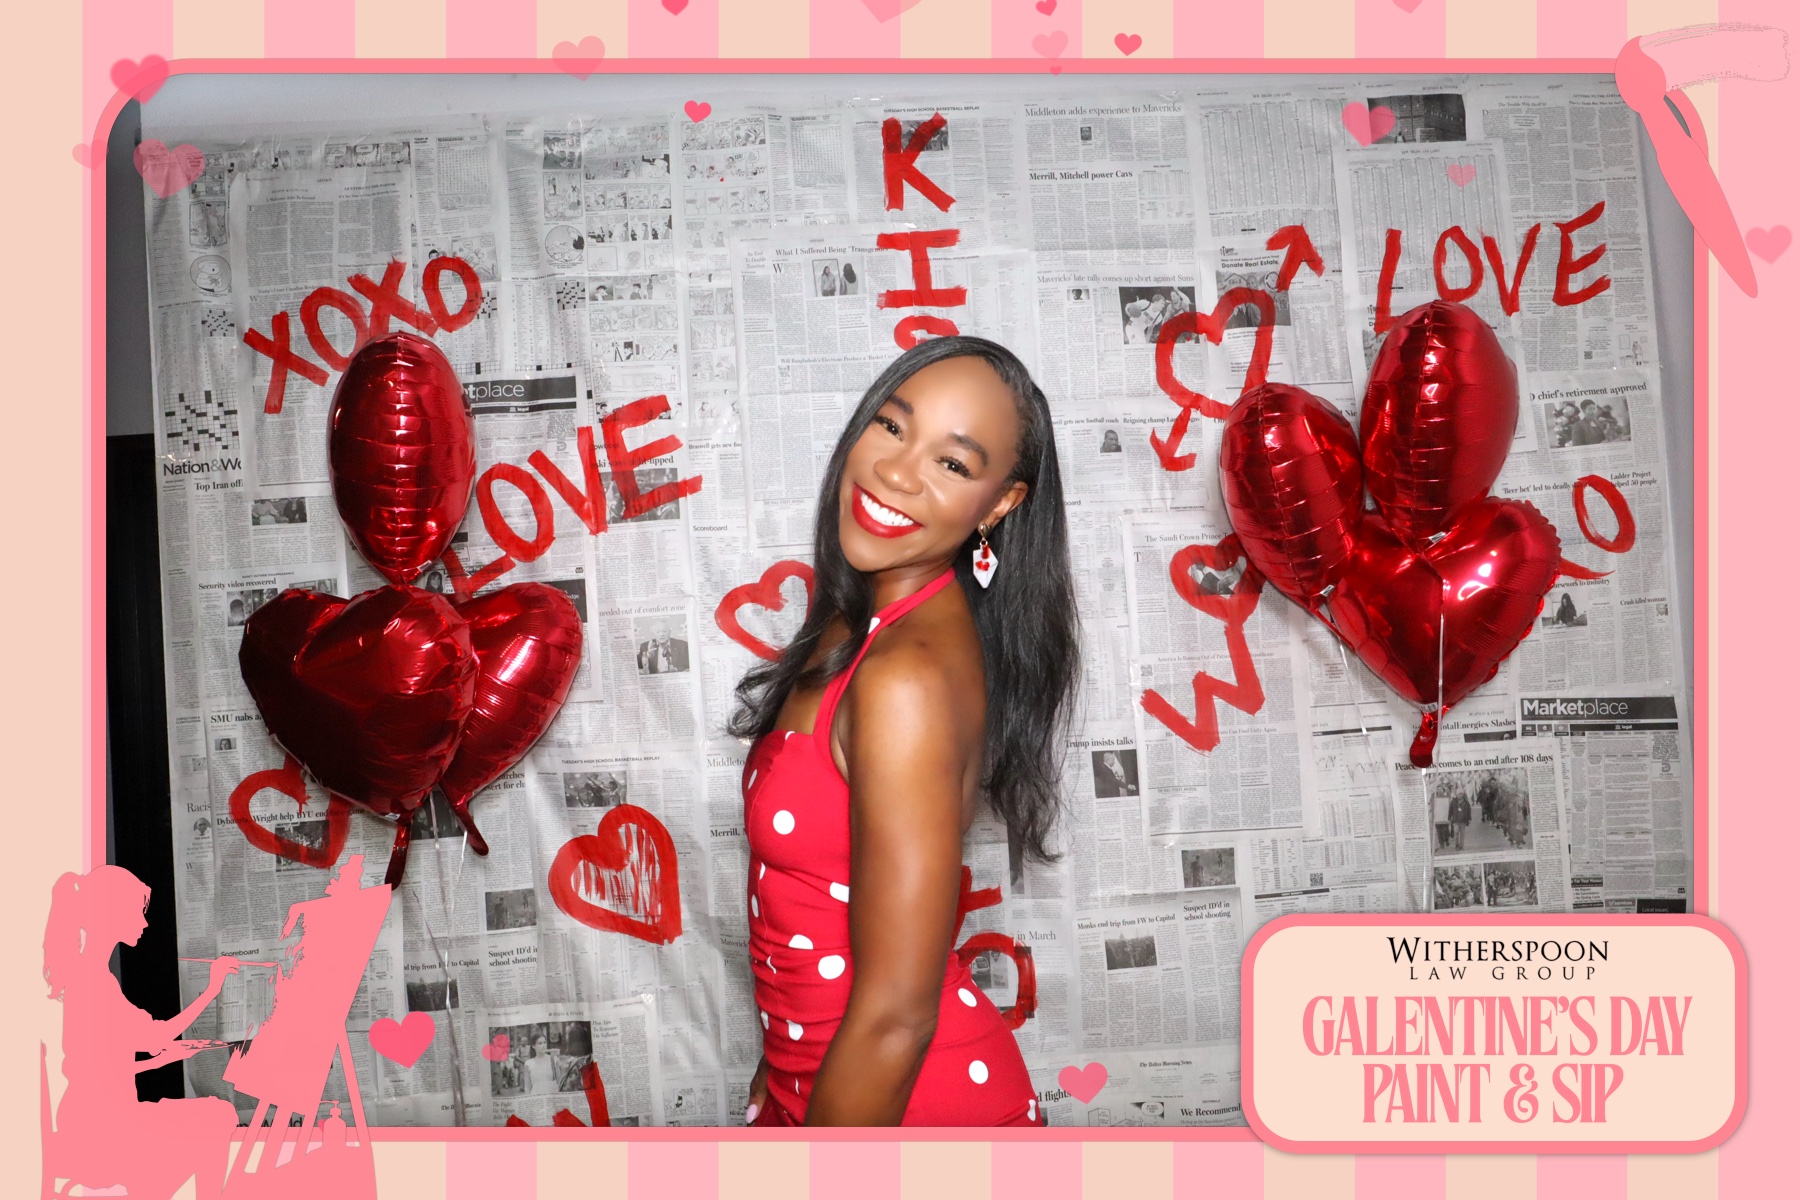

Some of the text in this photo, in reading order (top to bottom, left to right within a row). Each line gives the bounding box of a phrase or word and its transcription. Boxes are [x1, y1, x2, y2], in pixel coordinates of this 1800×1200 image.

[1025, 102, 1182, 117] Middleton adds experience to Mavericks
[1029, 169, 1133, 182] Merrill, Mitchell power Cavs
[775, 248, 793, 256] What
[800, 246, 827, 255] Suffered
[828, 246, 847, 256] Being
[1221, 261, 1243, 269] Donate
[1373, 200, 1611, 336] LOVE
[1073, 274, 1085, 282] late
[1087, 274, 1101, 284] rally
[1124, 276, 1133, 284] up
[1135, 273, 1151, 282] short
[1153, 273, 1175, 284] against
[1177, 273, 1194, 281] Suns
[243, 255, 483, 415] XOXO
[1537, 381, 1647, 401] chief's retirement approved
[1085, 416, 1104, 424] football
[1105, 416, 1119, 424] coach
[1123, 416, 1166, 426] Reigning champ
[688, 442, 709, 450] Braswell
[711, 442, 721, 450] gets
[1610, 471, 1651, 482] Ladder Project
[1631, 477, 1657, 487] 50 people
[194, 480, 229, 493] Top Iran
[1533, 483, 1544, 492] led
[1553, 481, 1571, 492] deadly
[441, 394, 703, 602] LOVE
[692, 524, 728, 532] Scoreboard
[1145, 532, 1221, 543] The Saudi Crown Prince
[198, 578, 277, 591] Security video recovered
[1620, 596, 1666, 606] Crash killed woman
[599, 604, 685, 617] needed out of comfort zone
[1523, 698, 1628, 718] Marketplace
[211, 712, 253, 724] SMU nabs
[1491, 719, 1516, 728] Slashes
[1064, 736, 1134, 750] Trump insists talks
[707, 758, 745, 768] Middleto
[1438, 761, 1462, 769] comes
[1485, 756, 1499, 765] end
[1500, 755, 1518, 764] after
[1521, 754, 1534, 763] 108
[1536, 753, 1553, 765] days
[503, 781, 514, 790] for
[253, 812, 278, 824] Wright
[279, 811, 295, 823] help
[296, 810, 314, 820] BYU
[710, 827, 740, 838] Merrill,
[1183, 903, 1207, 914] Suspect
[1208, 902, 1222, 910] ID'd
[1184, 910, 1231, 921] school shooting
[1077, 922, 1097, 931] Monks
[1097, 920, 1109, 928] end
[1109, 919, 1121, 929] trip
[1122, 918, 1136, 927] from
[1137, 917, 1148, 925] FW
[1155, 914, 1176, 924] Capitol
[1017, 930, 1056, 941] in March
[221, 948, 259, 958] Scoreboard
[488, 945, 531, 959] Suspect ID'd
[410, 958, 479, 972] trip from to Capitol
[489, 957, 510, 968] school
[1162, 1060, 1180, 1068] Morning
[1045, 1088, 1072, 1103] flights
[1180, 1103, 1242, 1117] We Recommend
